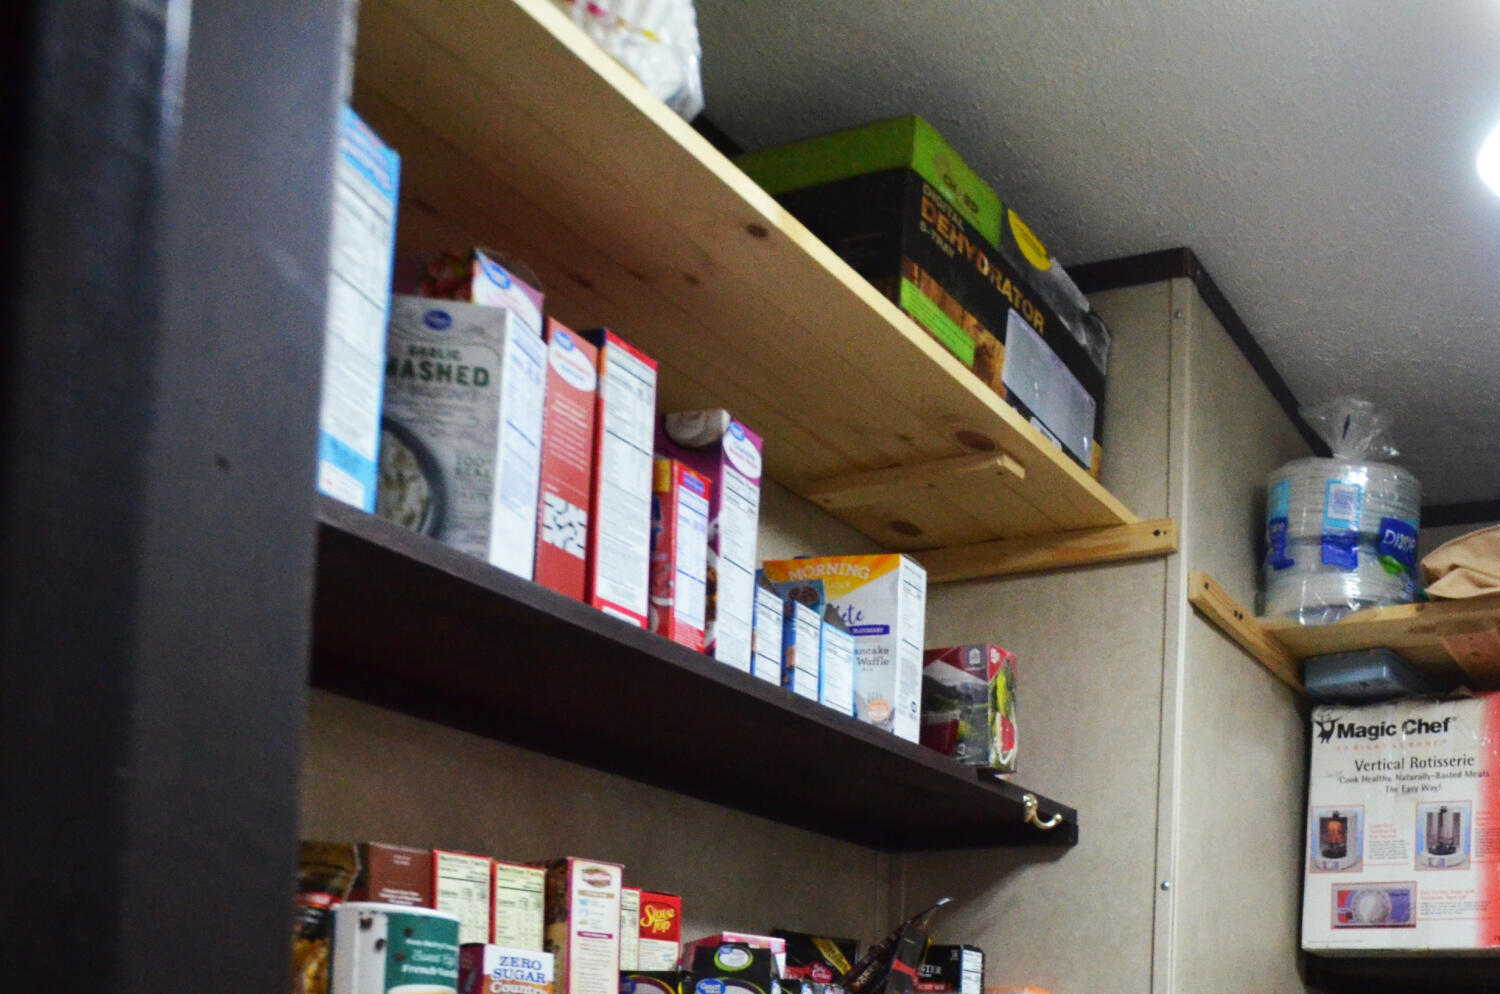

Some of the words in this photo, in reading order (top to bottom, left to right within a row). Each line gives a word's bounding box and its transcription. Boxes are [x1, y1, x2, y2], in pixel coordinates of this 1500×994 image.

[920, 196, 1046, 335] DEHYDRATOR
[787, 562, 871, 581] MORNING
[856, 646, 890, 657] ancake
[857, 656, 890, 667] Waffle
[1337, 721, 1398, 741] Magic
[1401, 716, 1451, 736] Chef
[1354, 757, 1406, 772] Vertical
[1410, 753, 1476, 770] Rotisserie
[1385, 785, 1399, 793] The
[1401, 785, 1419, 795] Easy
[499, 955, 543, 971] ZERO
[492, 968, 547, 984] SUGAR
